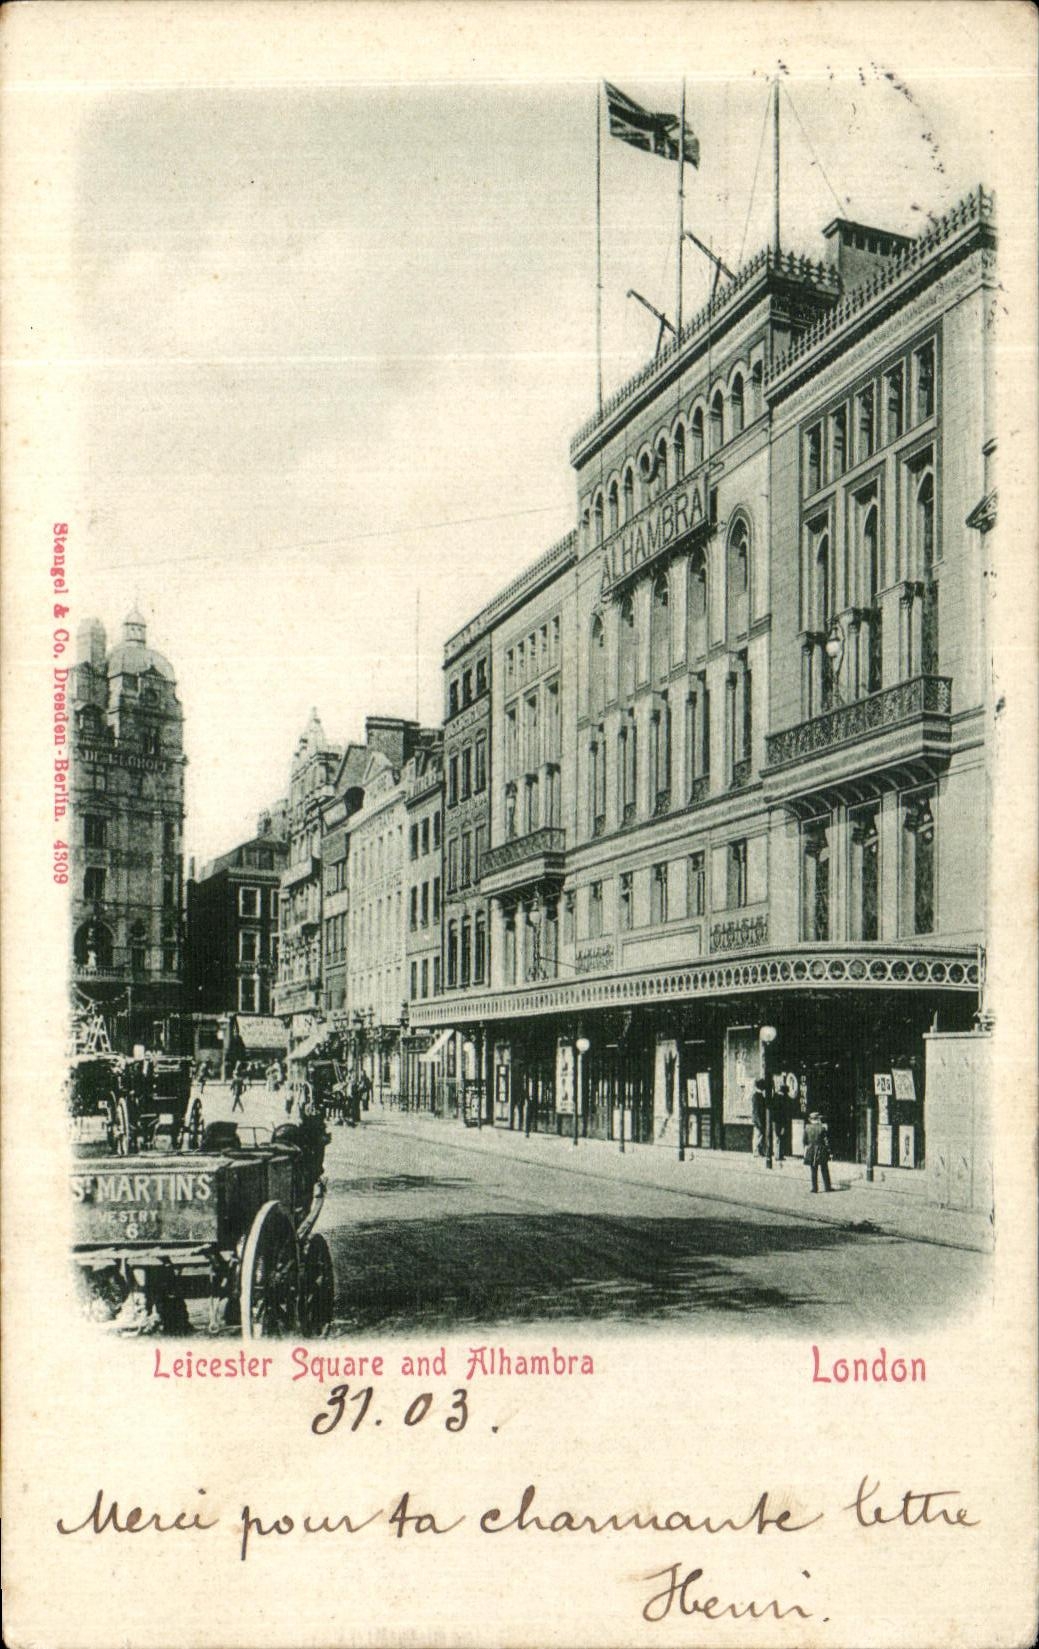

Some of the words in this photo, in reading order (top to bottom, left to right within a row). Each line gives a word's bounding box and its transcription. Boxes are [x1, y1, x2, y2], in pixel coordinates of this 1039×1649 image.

[601, 485, 704, 586] ALHAMBRA
[126, 1222, 139, 1239] 6
[57, 1488, 217, 1535] Merci
[240, 1505, 378, 1562] pour
[389, 1491, 462, 1539] ta
[479, 1484, 824, 1535] charmante
[843, 1474, 981, 1528] lettre
